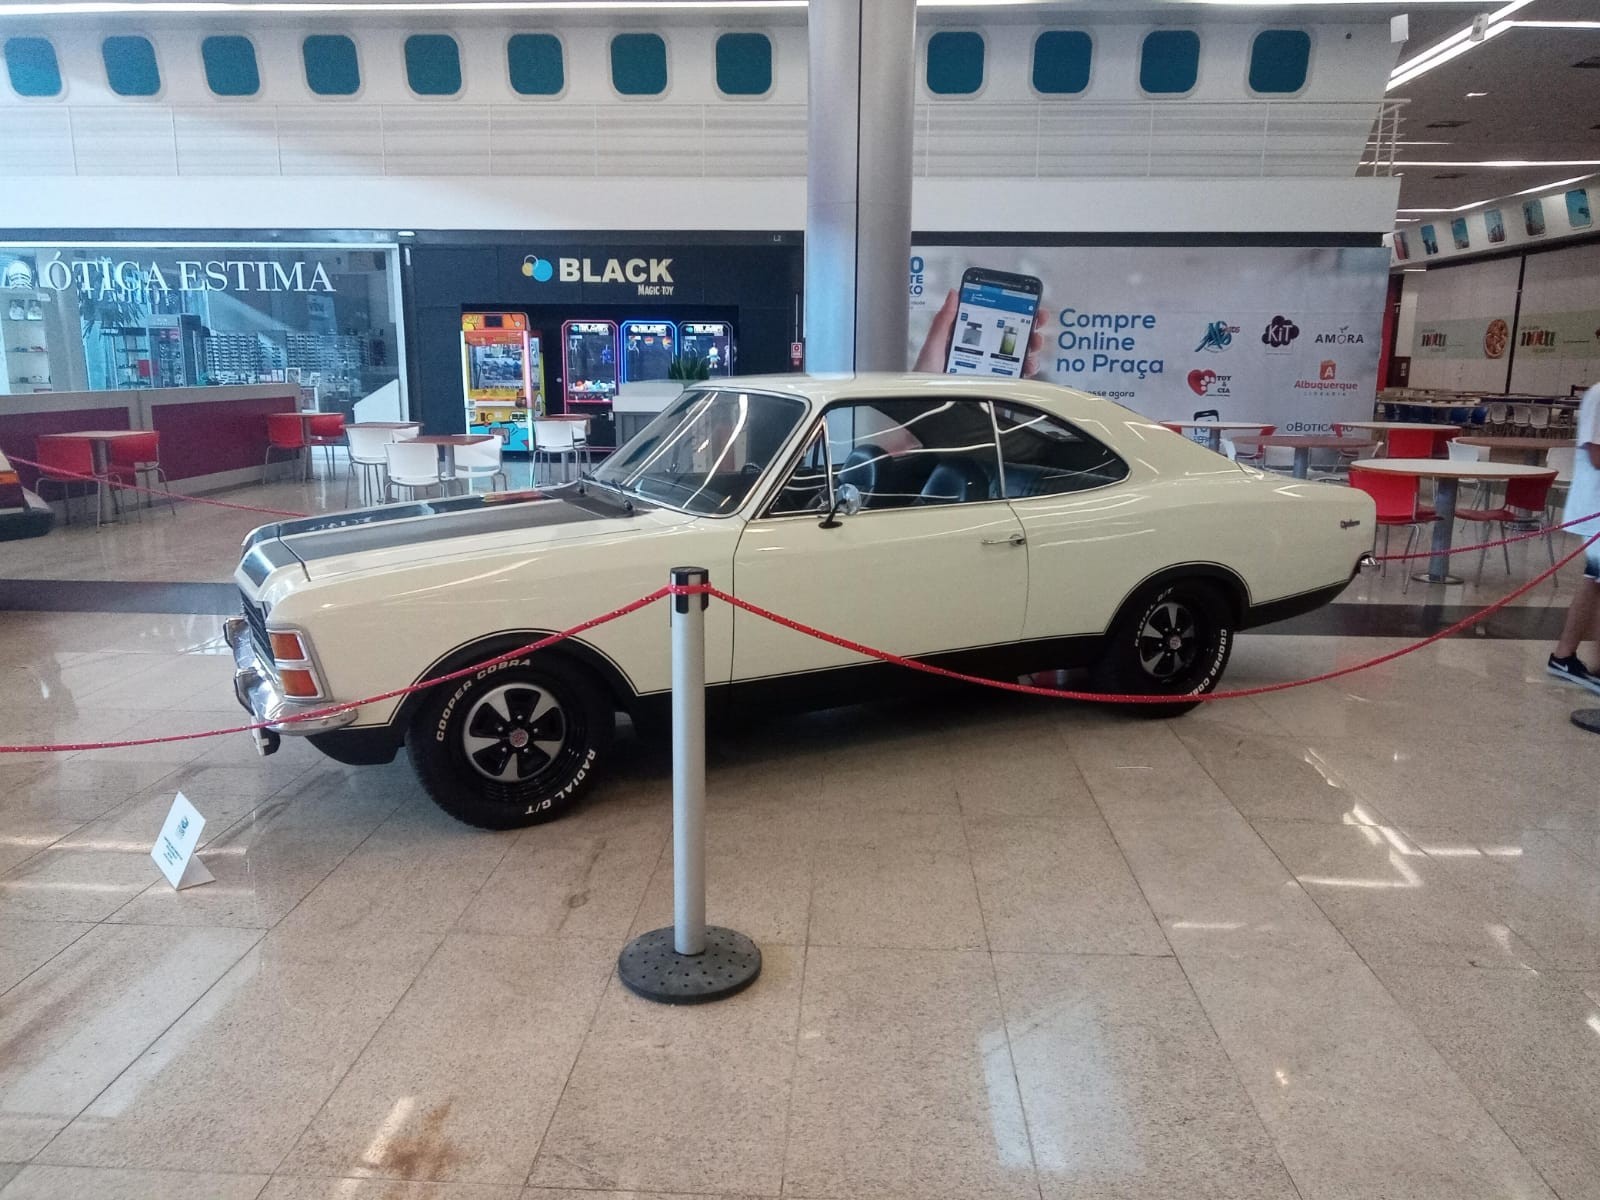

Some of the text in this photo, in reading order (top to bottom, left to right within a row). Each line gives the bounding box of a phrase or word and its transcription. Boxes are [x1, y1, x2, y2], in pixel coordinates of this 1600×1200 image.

[44, 251, 337, 292] ÓTICA ESTIMA
[559, 257, 675, 283] BLACK
[637, 284, 660, 296] MAGIC
[1059, 308, 1157, 334] Compre
[1057, 330, 1136, 351] Online
[1314, 333, 1365, 345] AMORA
[1056, 353, 1165, 380] no Praça
[1108, 390, 1136, 400] agora
[1293, 379, 1358, 391] Albuquerque
[436, 658, 531, 742] COOPER COBRA
[524, 748, 597, 815] RADIAL G/T
